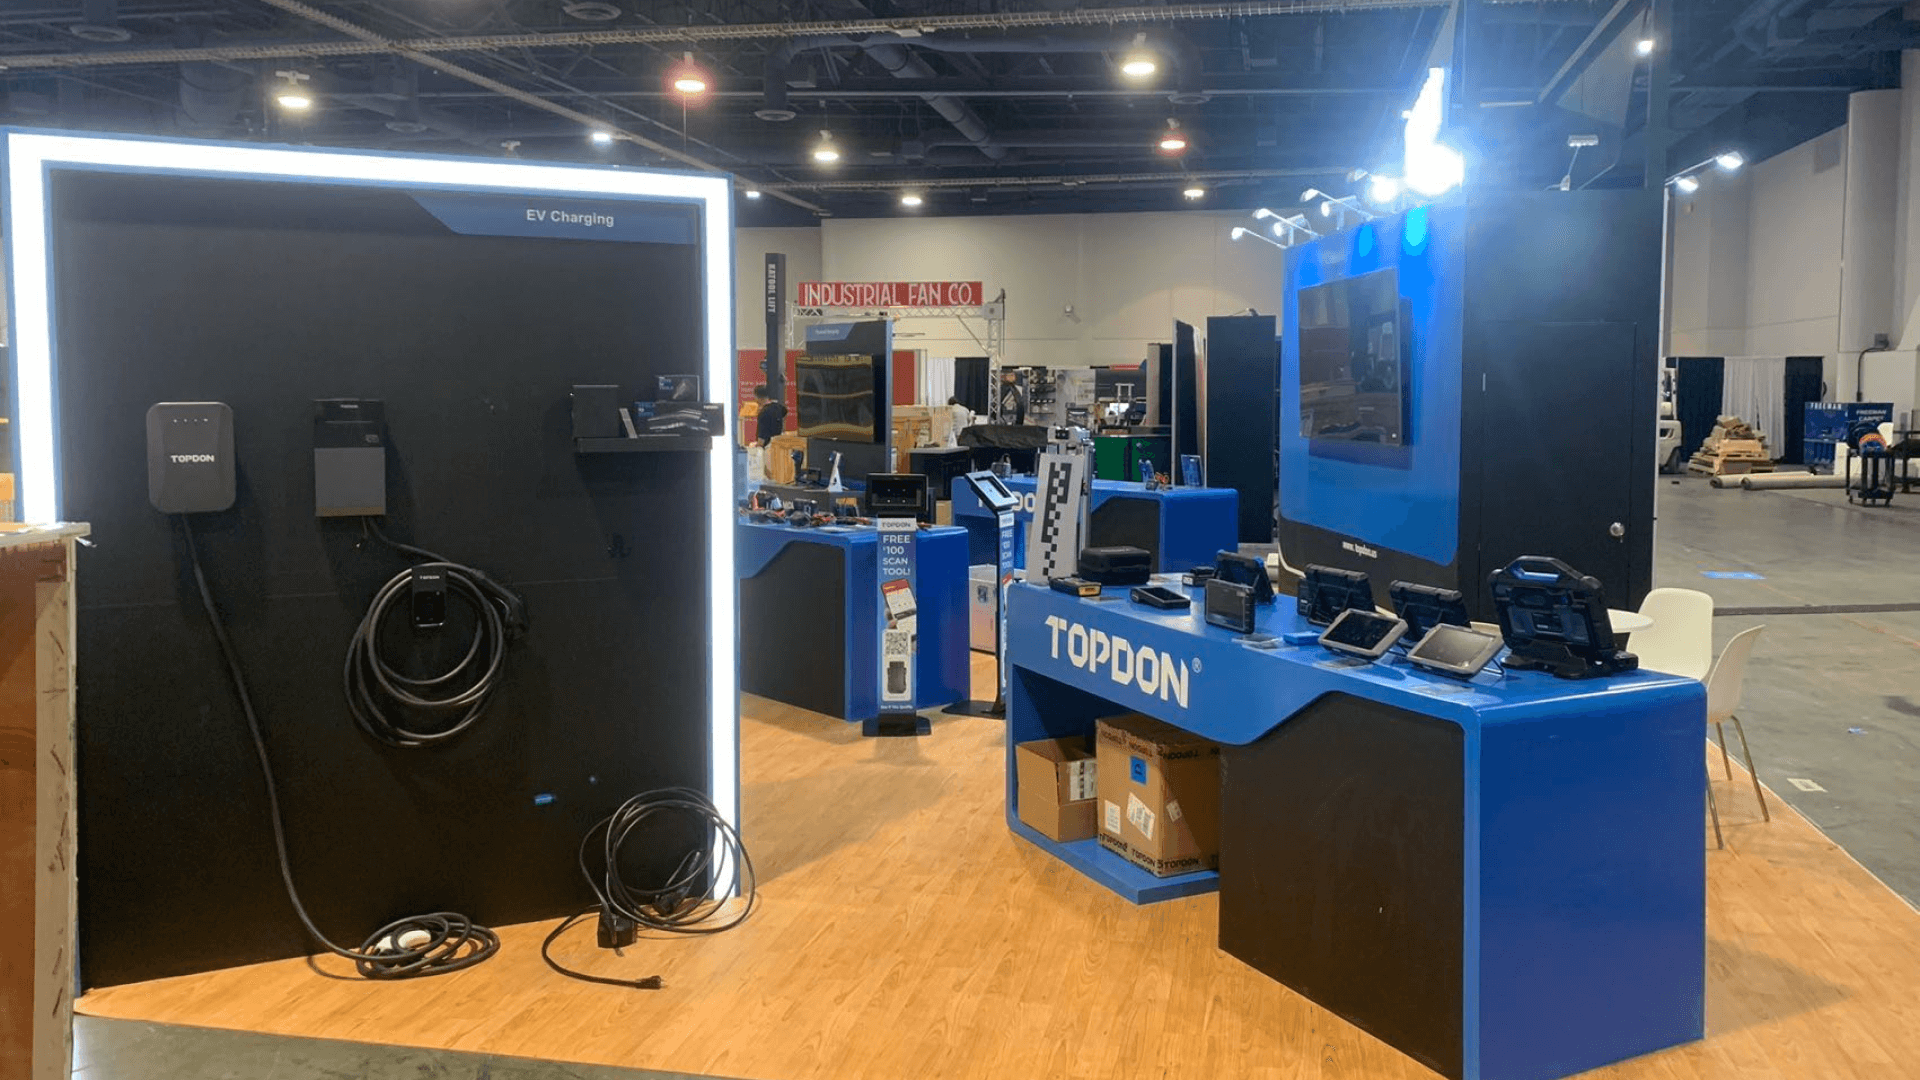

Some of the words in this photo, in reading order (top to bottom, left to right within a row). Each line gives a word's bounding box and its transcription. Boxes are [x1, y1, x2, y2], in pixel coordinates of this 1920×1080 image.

[526, 208, 546, 222] EV
[550, 209, 615, 228] Charging
[804, 283, 901, 306] INDUSTRIAL
[908, 283, 941, 305] FAN
[948, 282, 976, 305] CO.
[170, 453, 215, 464] TOPDON
[882, 534, 911, 544] FREE
[882, 557, 909, 566] SCAN
[882, 567, 911, 576] TOOL!
[1045, 614, 1189, 709] TOPDON
